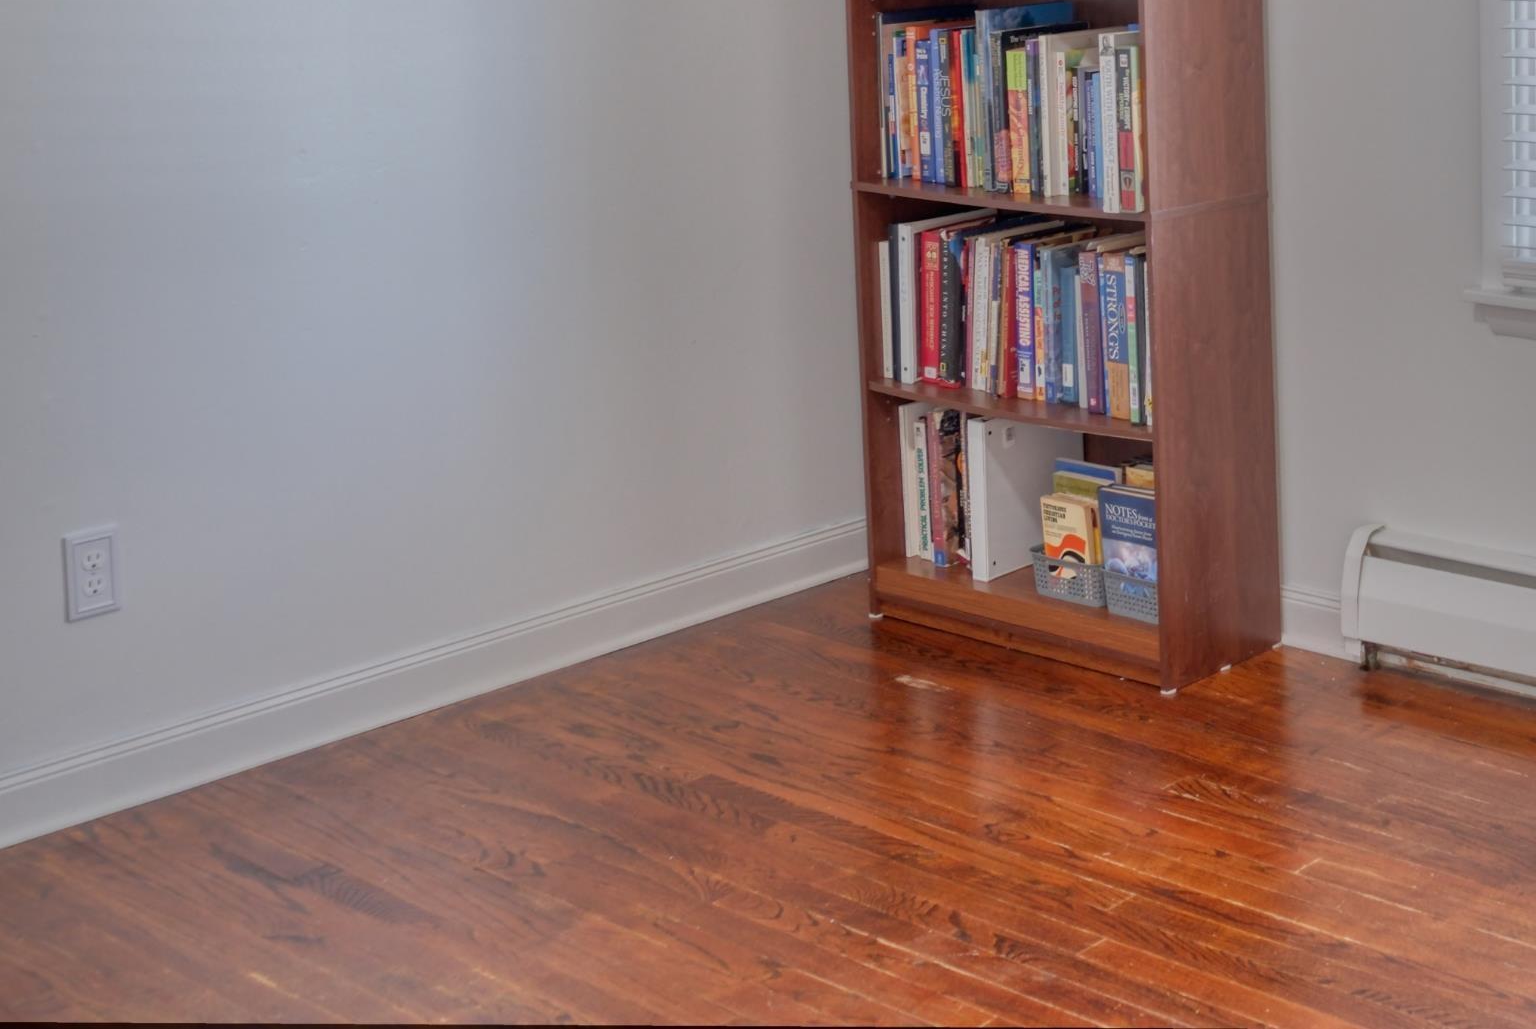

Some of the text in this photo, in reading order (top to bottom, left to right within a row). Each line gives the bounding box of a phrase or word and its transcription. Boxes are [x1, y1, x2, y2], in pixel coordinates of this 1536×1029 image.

[939, 71, 952, 117] JESUS
[1106, 90, 1116, 110] WITH
[1122, 77, 1131, 103] VICTORY
[942, 291, 950, 319] INTO
[1016, 248, 1032, 347] MEDICAL ASSISTING
[940, 323, 949, 358] CHINA
[1105, 503, 1138, 519] NOTES
